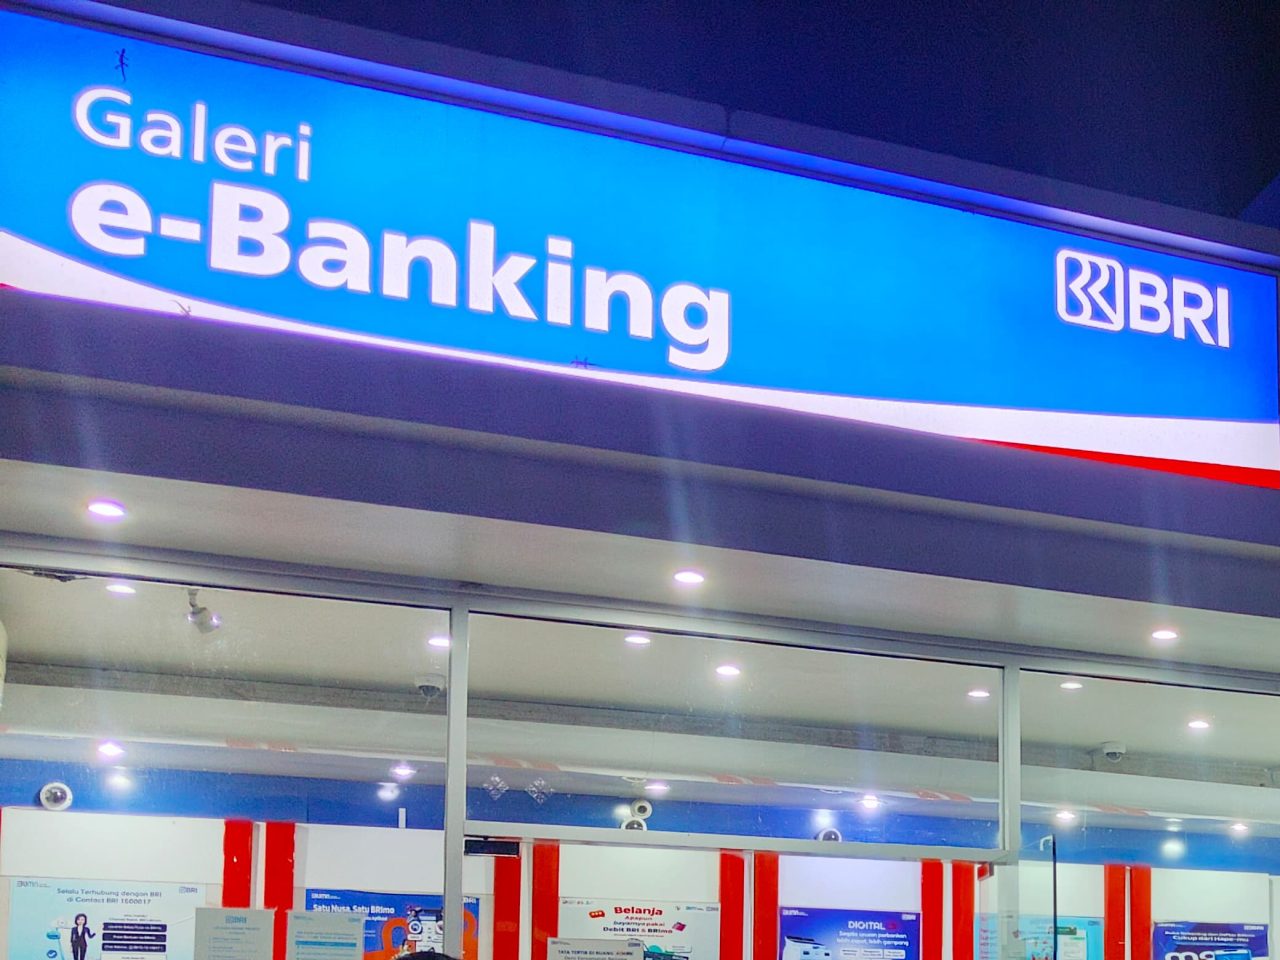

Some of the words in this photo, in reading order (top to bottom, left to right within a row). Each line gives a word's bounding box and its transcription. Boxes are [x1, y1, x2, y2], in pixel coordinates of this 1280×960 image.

[74, 88, 312, 181] Galeri
[70, 182, 731, 372] e-Banking
[1129, 268, 1230, 348] BRI
[81, 888, 119, 897] Terhubung
[313, 904, 330, 913] Satu
[353, 906, 370, 914] Satu
[614, 906, 663, 917] Belanja
